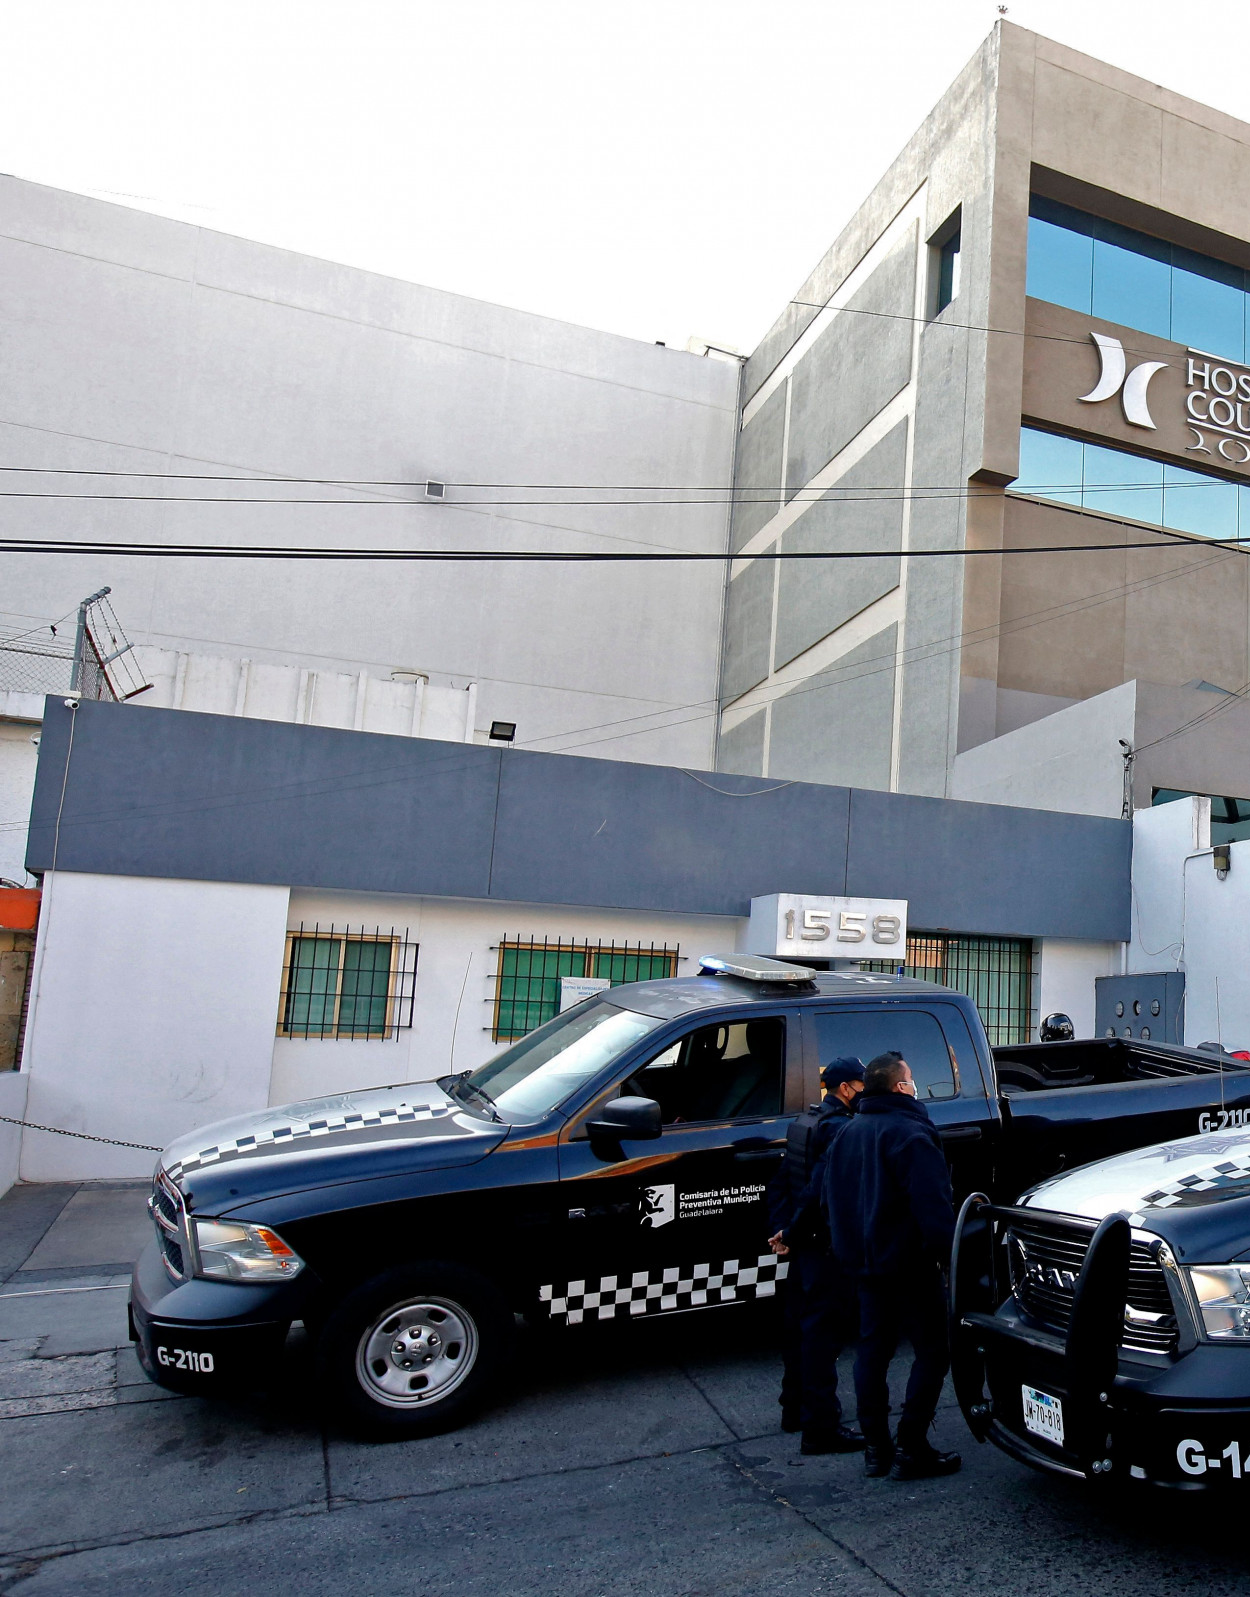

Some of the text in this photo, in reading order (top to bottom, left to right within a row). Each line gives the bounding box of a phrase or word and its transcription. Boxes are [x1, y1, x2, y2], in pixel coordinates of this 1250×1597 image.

[785, 909, 901, 944] 1558
[719, 1188, 729, 1196] de
[731, 1187, 739, 1195] la
[740, 1184, 766, 1194] Policía
[680, 1193, 760, 1210] Preventiva Municipal
[157, 1346, 214, 1373] G-2110
